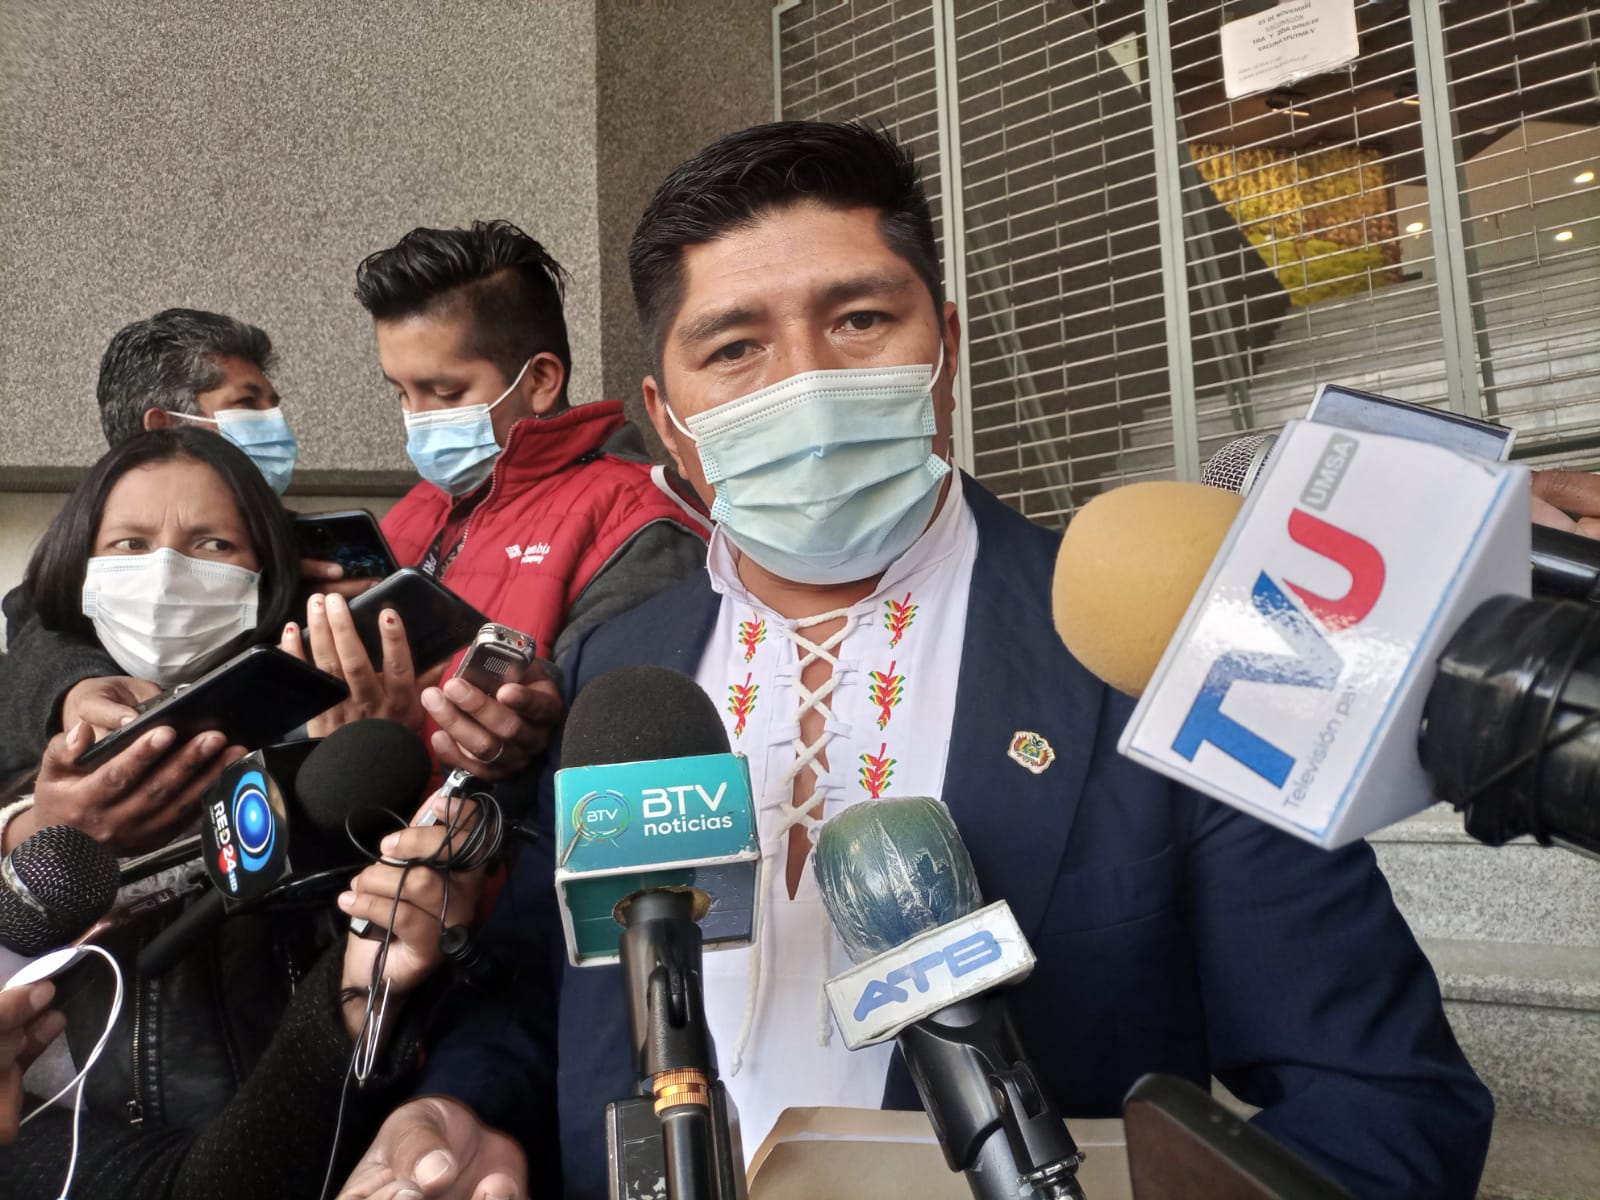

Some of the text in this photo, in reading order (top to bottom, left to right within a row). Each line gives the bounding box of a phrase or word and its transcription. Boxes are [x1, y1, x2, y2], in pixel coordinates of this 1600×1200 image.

[1304, 441, 1355, 504] UMSA
[1171, 507, 1387, 790] TVU
[1283, 685, 1357, 808] Televisión pa
[586, 808, 618, 823] BTV
[641, 781, 728, 819] BTV
[643, 814, 733, 836] noticias
[853, 930, 1003, 1022] ATB
